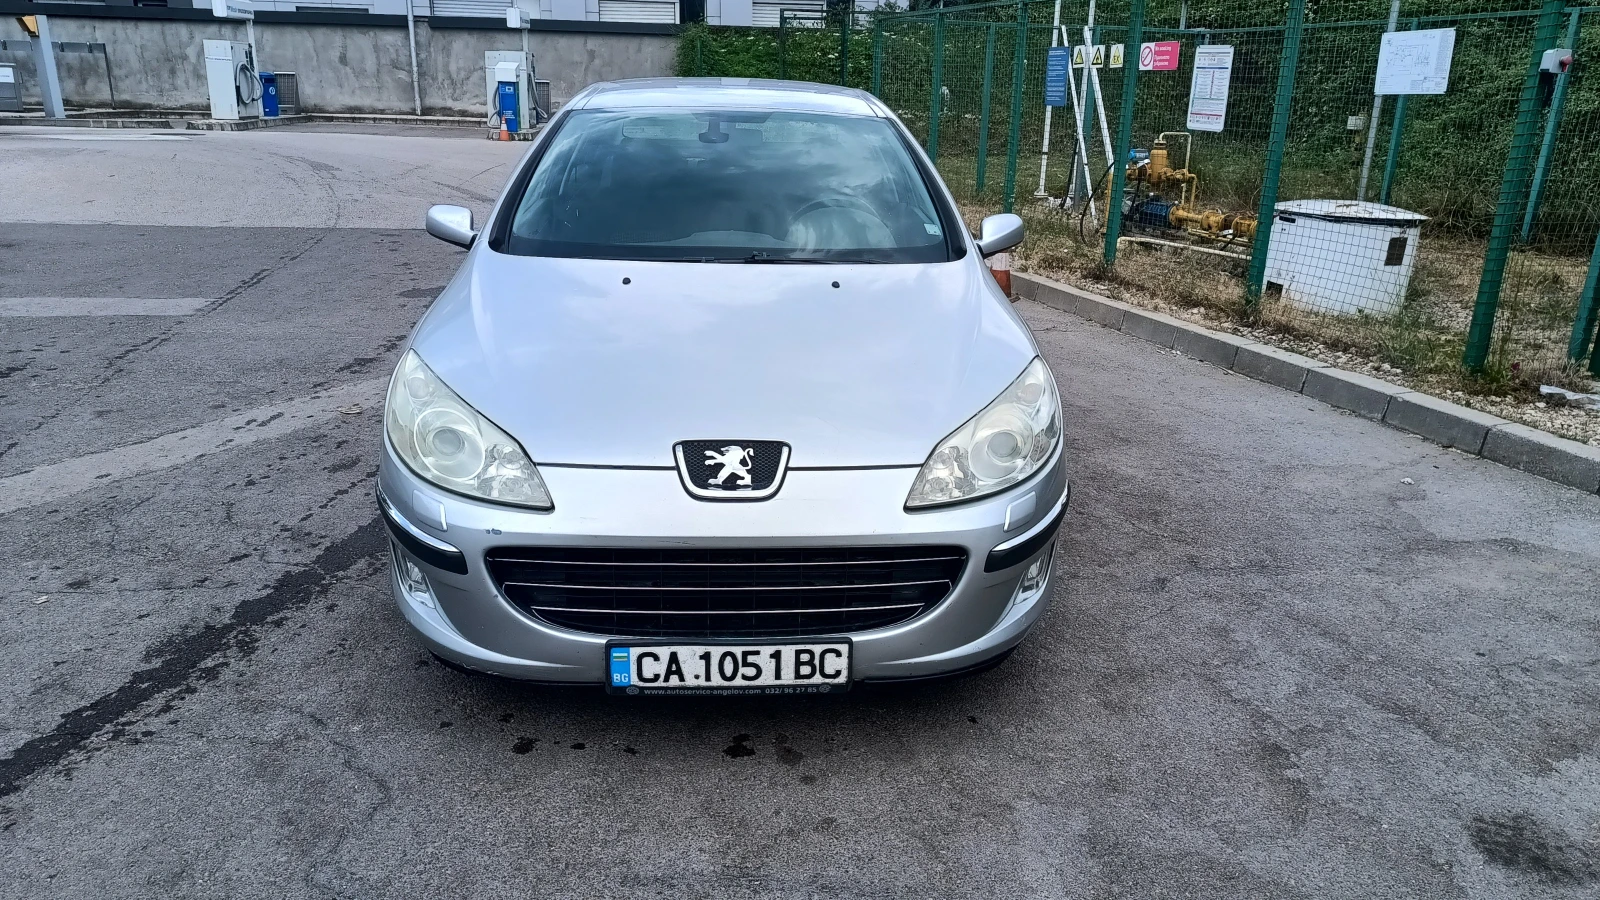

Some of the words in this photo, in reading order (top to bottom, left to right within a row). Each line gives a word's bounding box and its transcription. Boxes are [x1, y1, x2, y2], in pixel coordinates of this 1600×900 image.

[636, 651, 686, 683] CA
[699, 650, 782, 682] 1051
[794, 648, 842, 680] BC
[613, 673, 629, 683] BG
[644, 687, 761, 695] www.autoservice-angelov.com
